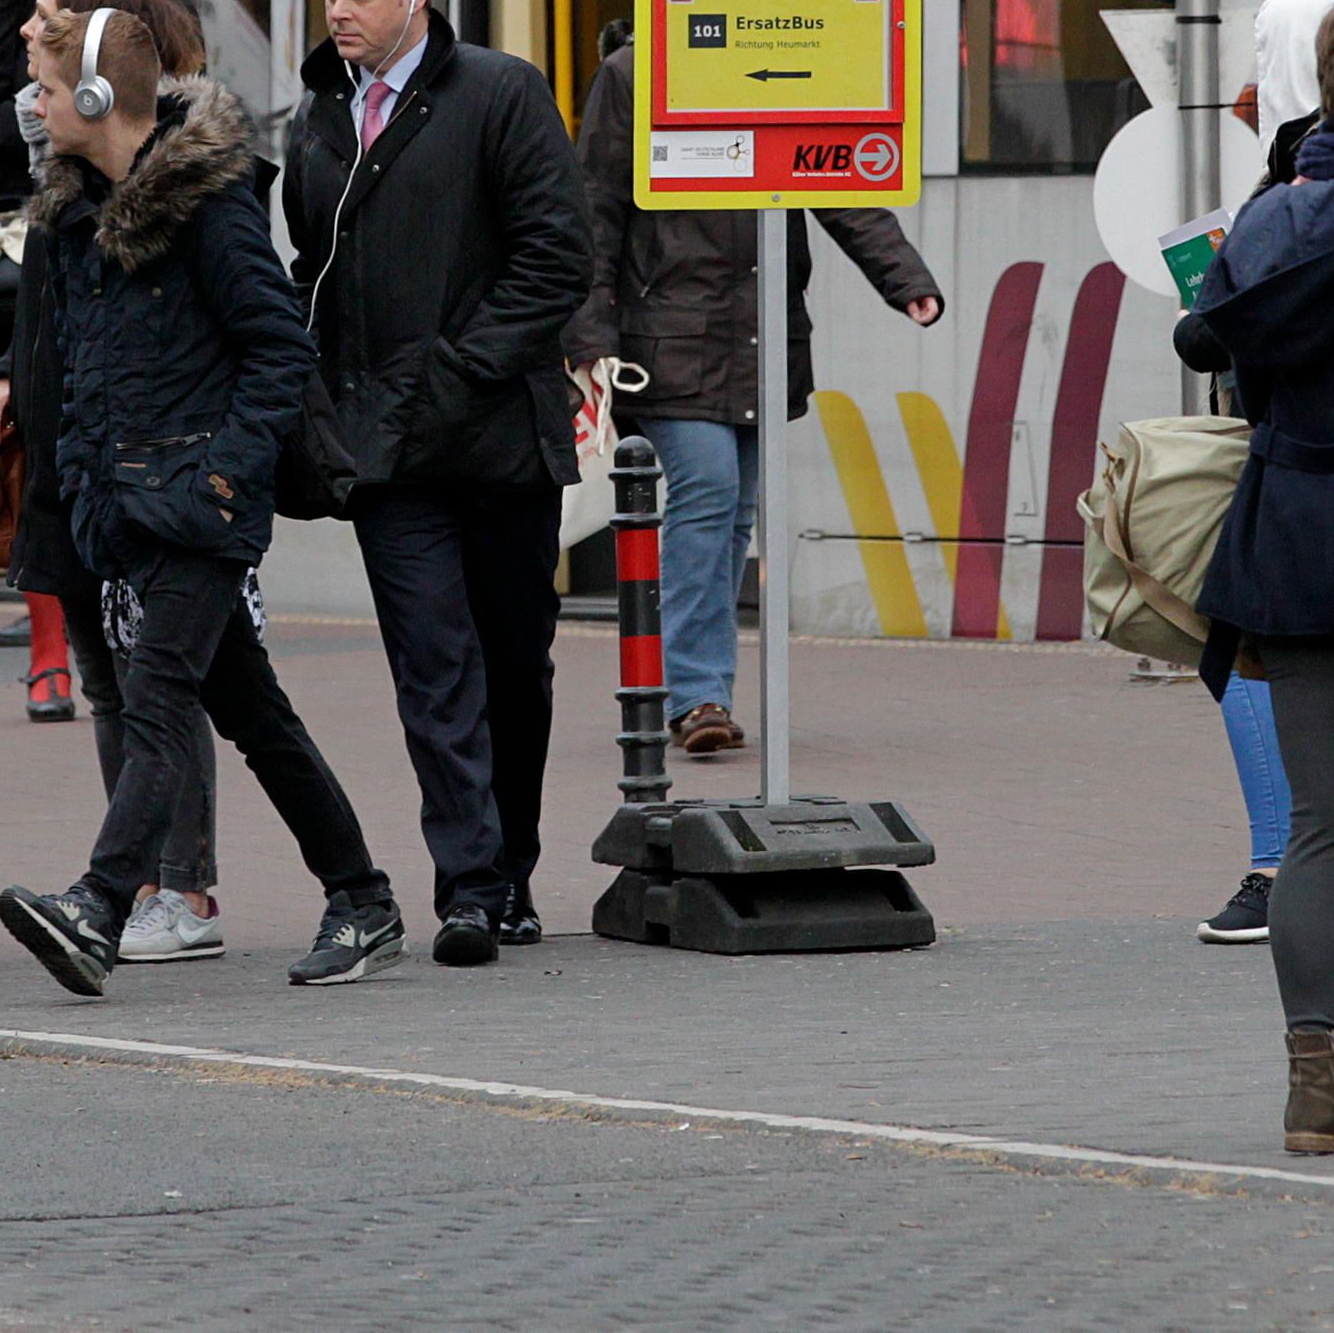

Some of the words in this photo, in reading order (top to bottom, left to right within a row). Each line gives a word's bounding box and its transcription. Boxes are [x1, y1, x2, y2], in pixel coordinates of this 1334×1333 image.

[693, 25, 721, 37] 101
[735, 16, 825, 30] ErsatzBus
[735, 40, 774, 50] Richtung
[776, 39, 821, 49] Heumarkt
[792, 143, 854, 172] KVB
